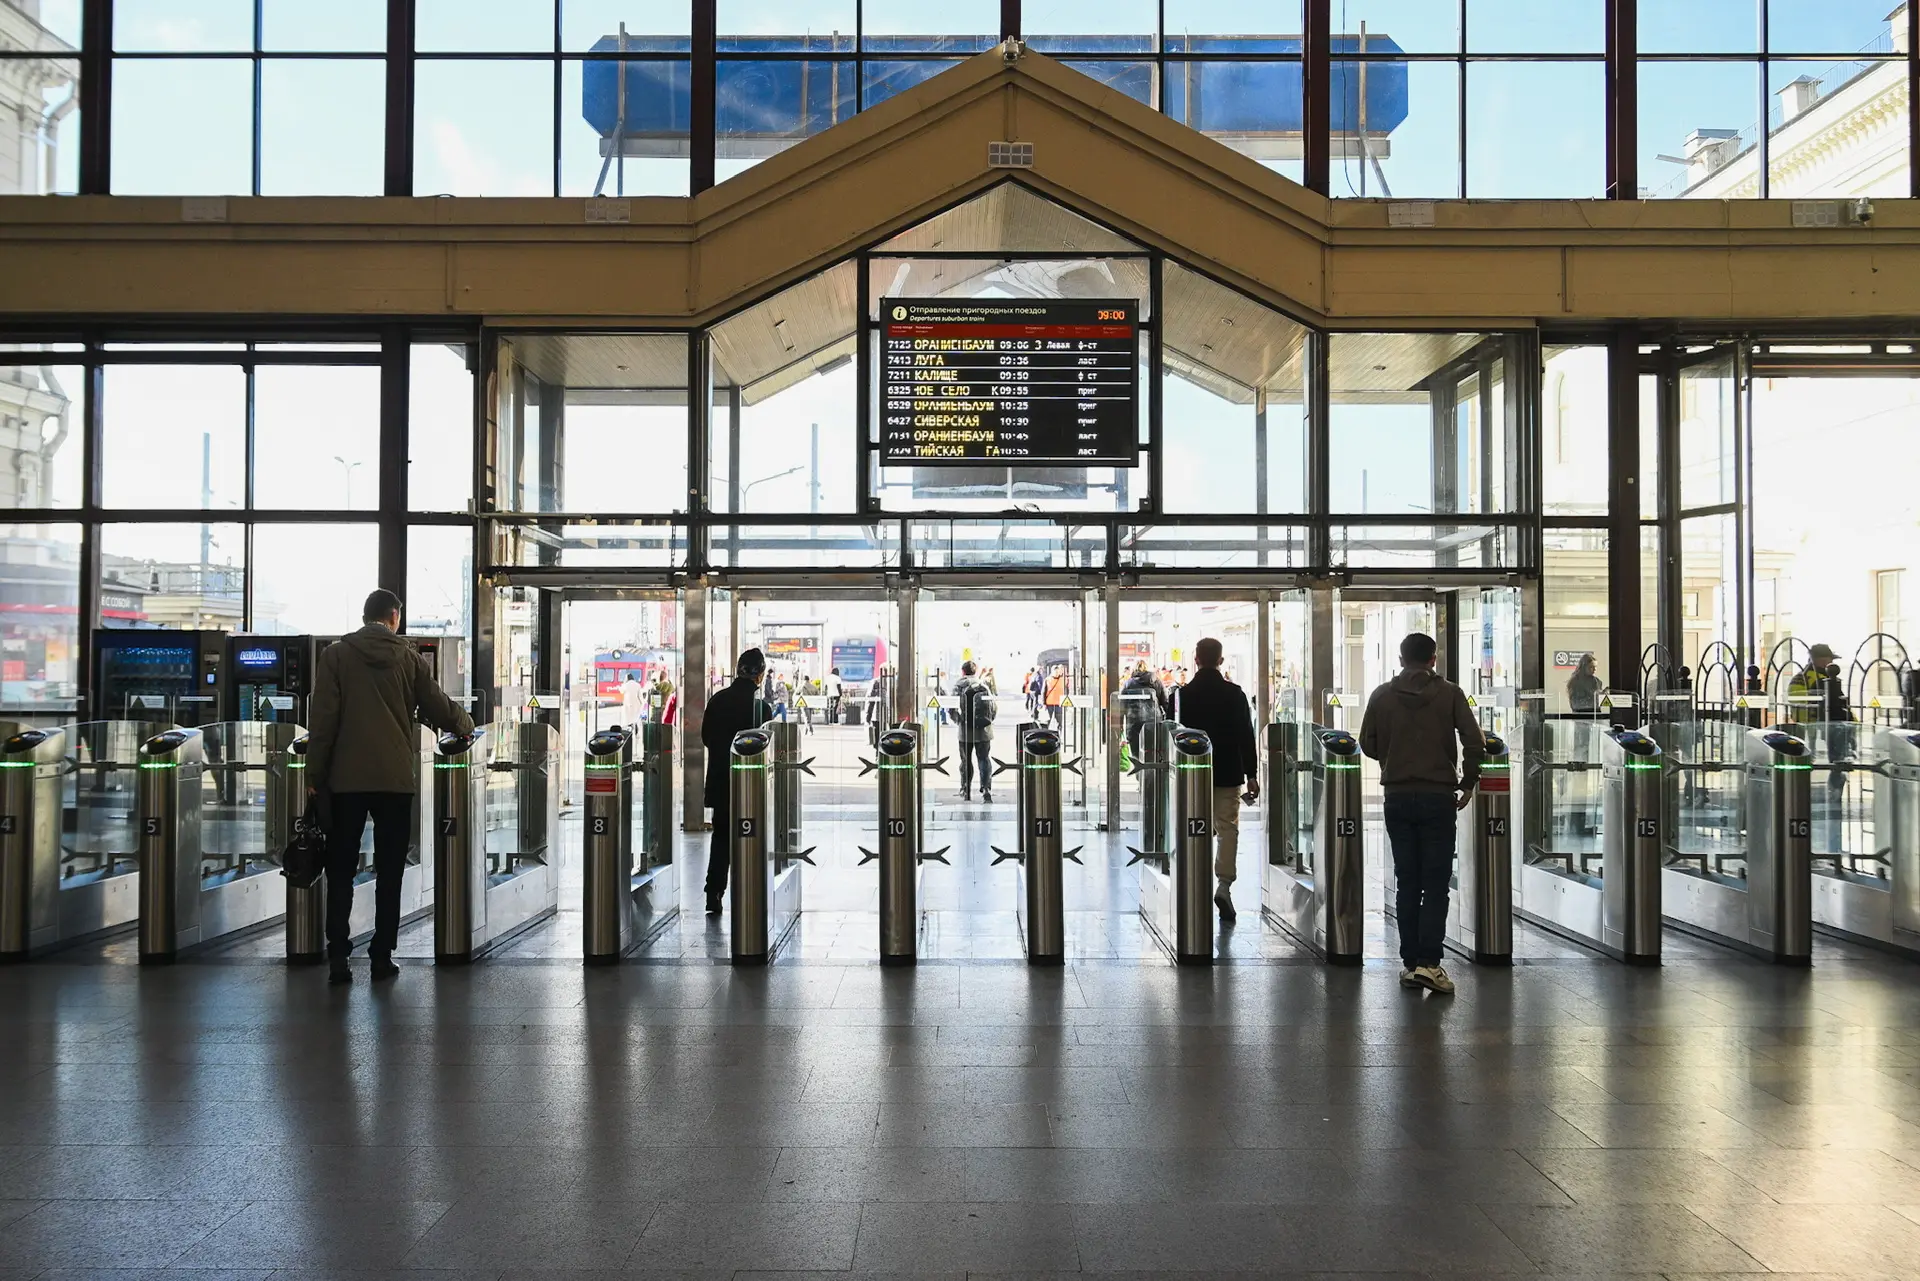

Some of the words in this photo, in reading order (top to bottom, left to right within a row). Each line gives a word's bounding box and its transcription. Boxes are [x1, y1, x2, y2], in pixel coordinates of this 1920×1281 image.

[909, 306, 961, 315] Отправление
[962, 306, 1013, 316] пригородных
[1014, 307, 1047, 316] поездов
[1097, 310, 1126, 320] 09:00
[1034, 340, 1042, 350] 3
[914, 354, 945, 366] ЛУГА
[888, 371, 910, 380] 7211
[914, 370, 958, 382] КАЛИЩЕ
[999, 371, 1029, 380] 09:50
[887, 386, 911, 394] 6325
[941, 385, 970, 395] СЕЛО
[999, 386, 1029, 395] 09:55
[1077, 387, 1098, 396] приг
[887, 401, 911, 410] 6529
[999, 401, 1029, 410] 10:25
[1077, 402, 1098, 411] приг
[887, 416, 911, 425] 6427
[914, 415, 980, 427] СИВЕРСКАЯ
[999, 417, 1029, 426] 10:30
[914, 430, 995, 441] ОРАНИЕНБАУМ
[807, 638, 814, 648] 3
[1141, 644, 1147, 653] 2
[147, 819, 156, 833] 5
[443, 819, 452, 833] 7
[594, 819, 604, 833] 8
[742, 820, 752, 834] 9
[888, 820, 905, 835] 10
[1036, 820, 1052, 834] 11
[1189, 820, 1206, 834] 12
[1338, 820, 1355, 834] 13
[1488, 820, 1505, 834] 14
[1639, 820, 1656, 835] 15
[1791, 820, 1808, 835] 16
